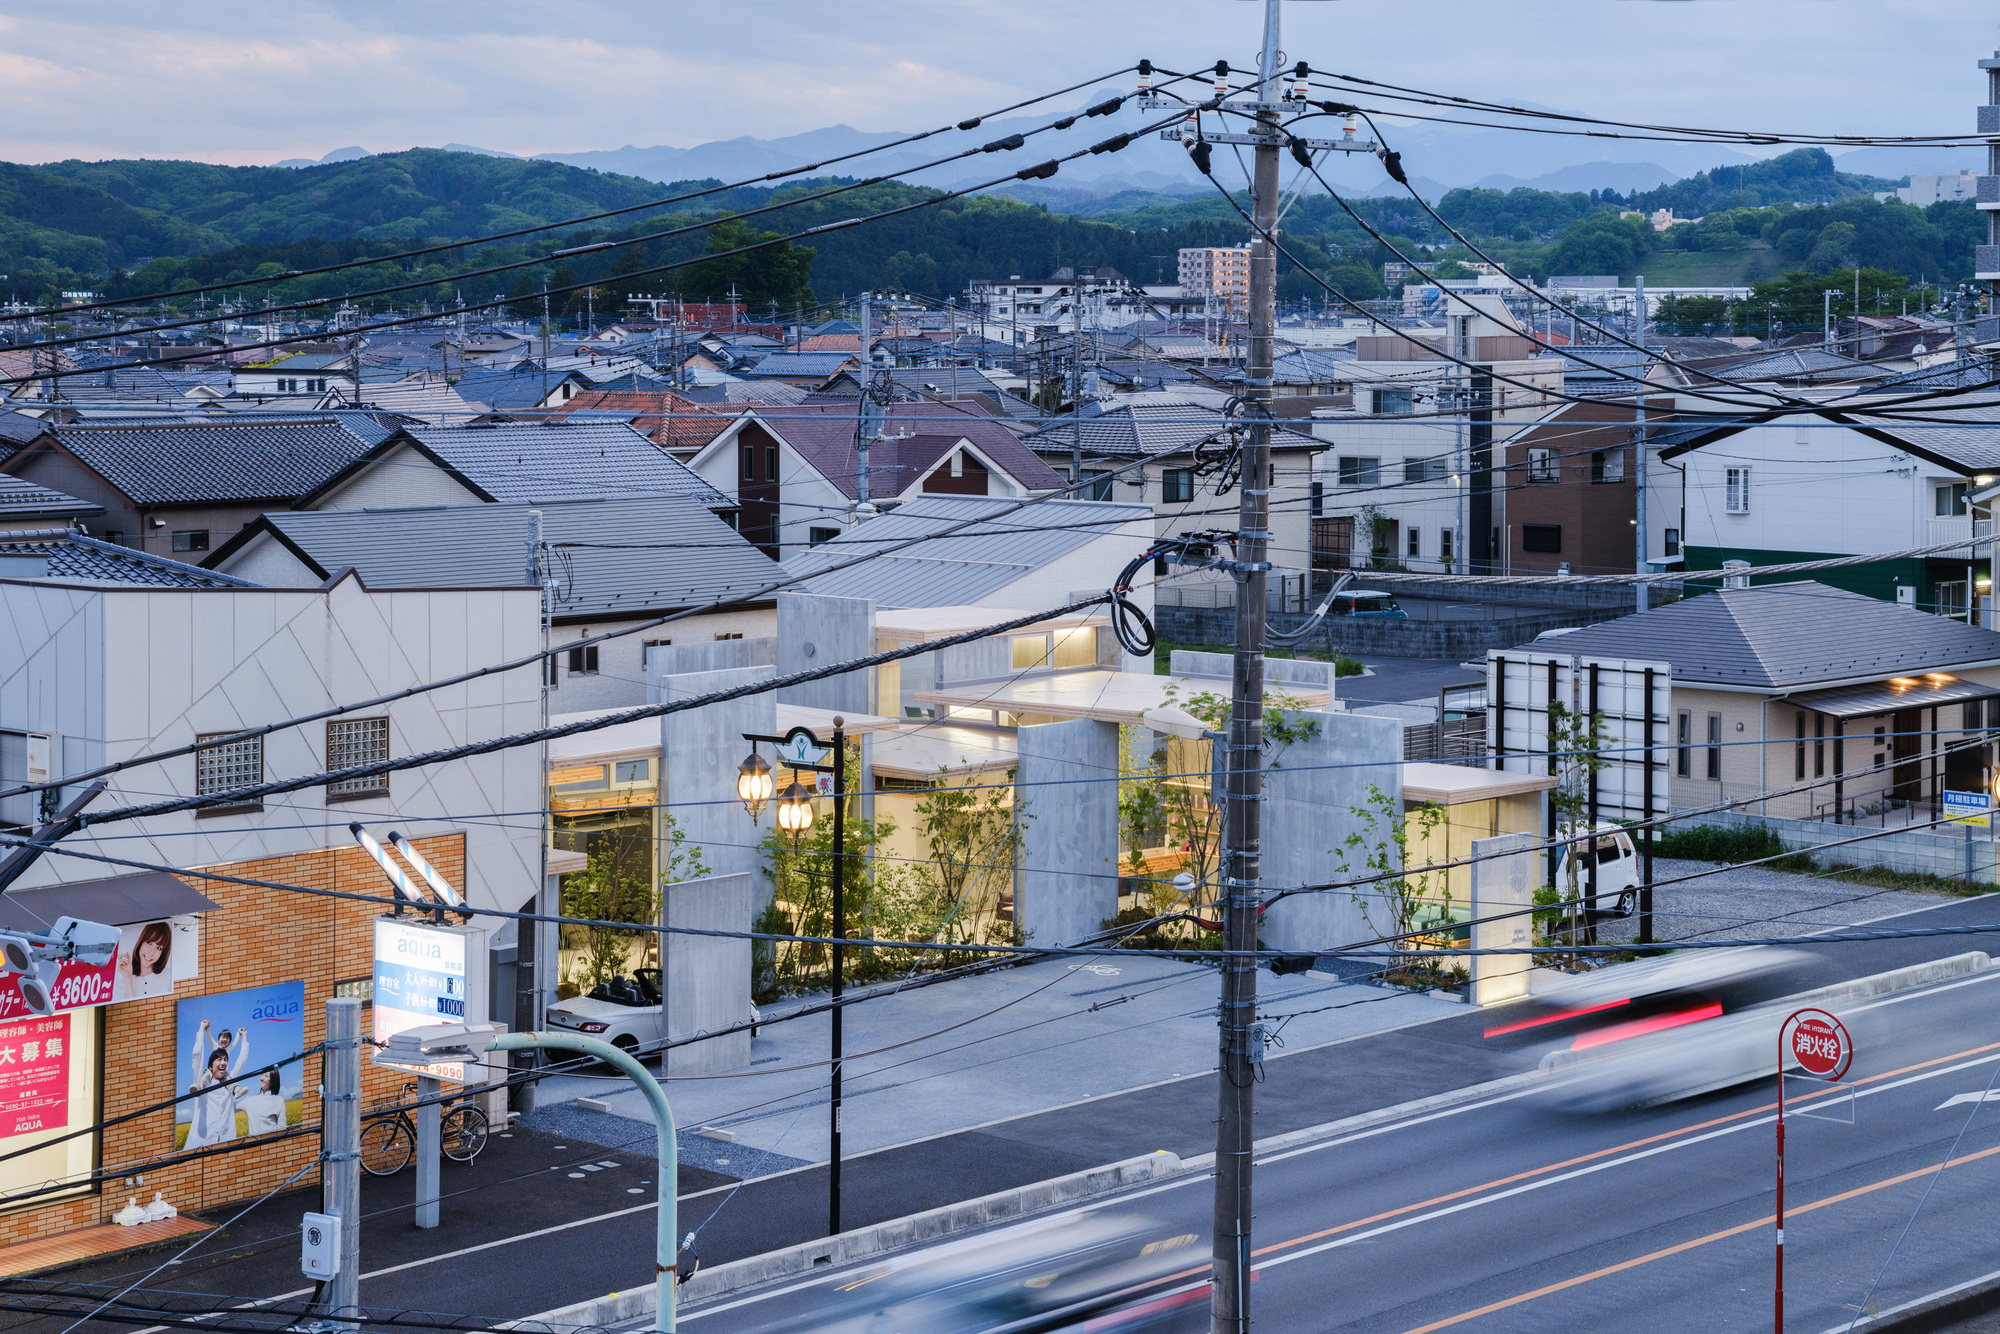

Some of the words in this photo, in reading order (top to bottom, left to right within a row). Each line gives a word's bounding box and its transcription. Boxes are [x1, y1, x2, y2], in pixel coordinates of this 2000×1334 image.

[1947, 793, 1986, 806] 月極駐車場
[378, 975, 400, 990] 理容室
[256, 997, 277, 1006] Family
[277, 994, 294, 1002] Salon
[1800, 1023, 1811, 1031] FIRE
[1811, 1025, 1834, 1035] HYDRANT
[0, 1037, 63, 1066] 大募集
[1796, 1032, 1838, 1060] 消火栓
[16, 1115, 27, 1123] Hair
[27, 1113, 41, 1121] Salon
[14, 1119, 43, 1133] AQUA
